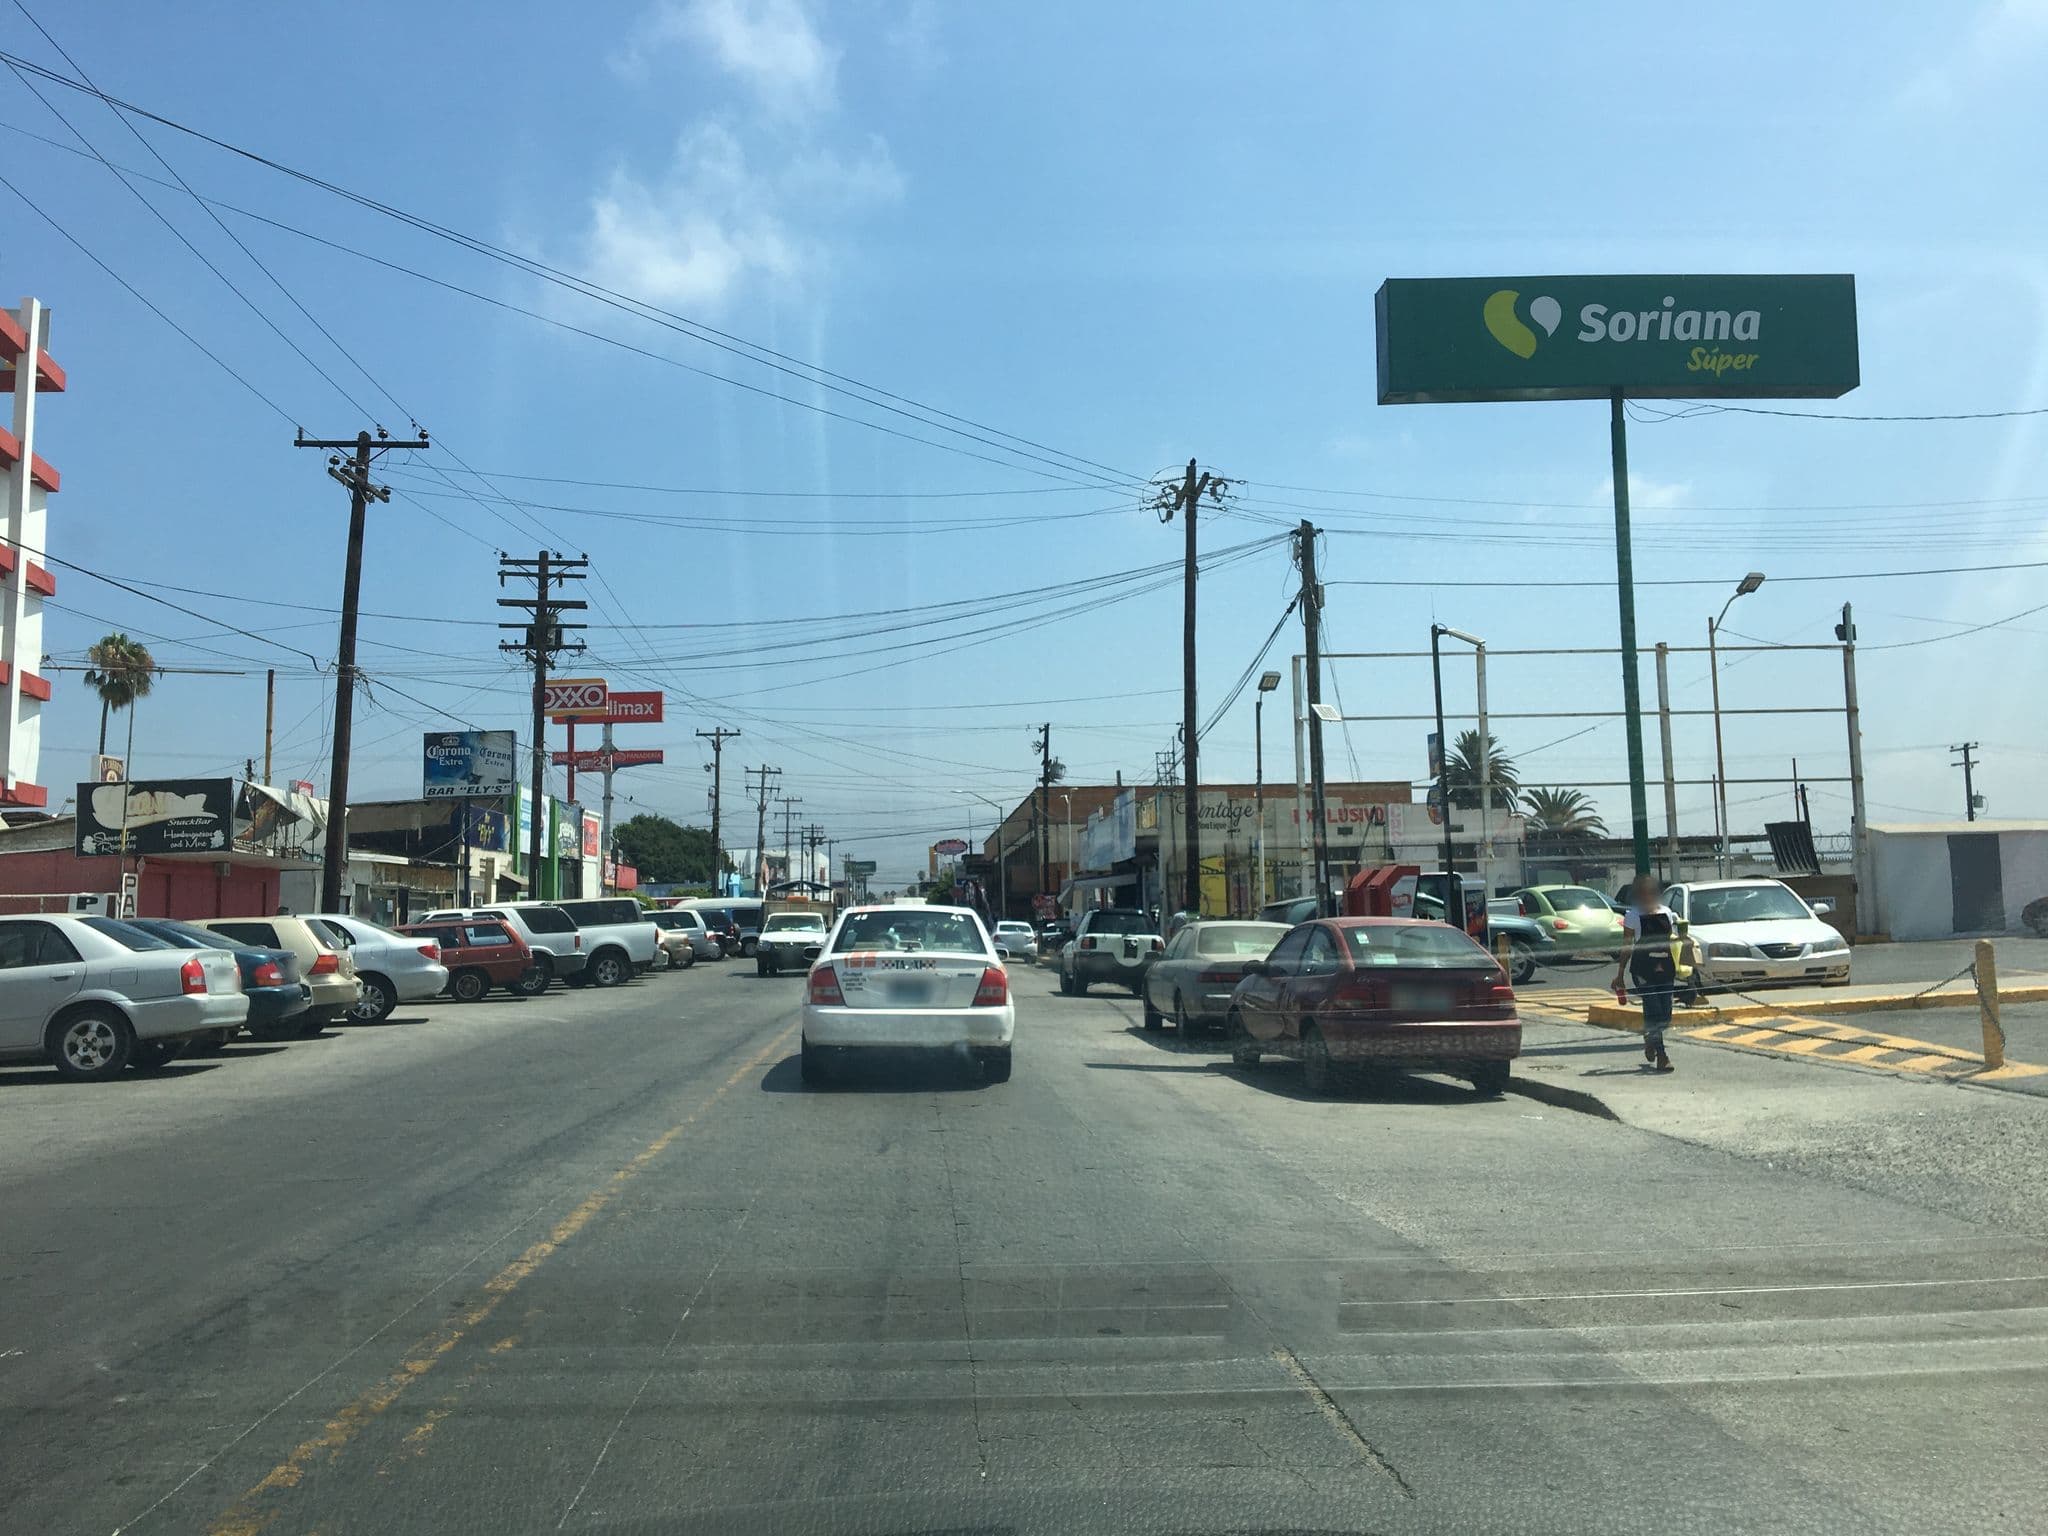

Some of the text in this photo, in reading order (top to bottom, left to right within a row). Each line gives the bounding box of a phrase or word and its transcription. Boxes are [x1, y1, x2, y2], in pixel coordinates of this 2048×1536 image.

[1577, 296, 1761, 343] Soriana
[1686, 346, 1761, 378] Súper
[544, 685, 604, 710] OXXO
[426, 745, 471, 760] Corona
[440, 757, 464, 766] Extra
[427, 786, 455, 796] BAR
[1175, 799, 1255, 828] intage
[1291, 807, 1385, 825] EXLUSIVO
[76, 897, 99, 910] P
